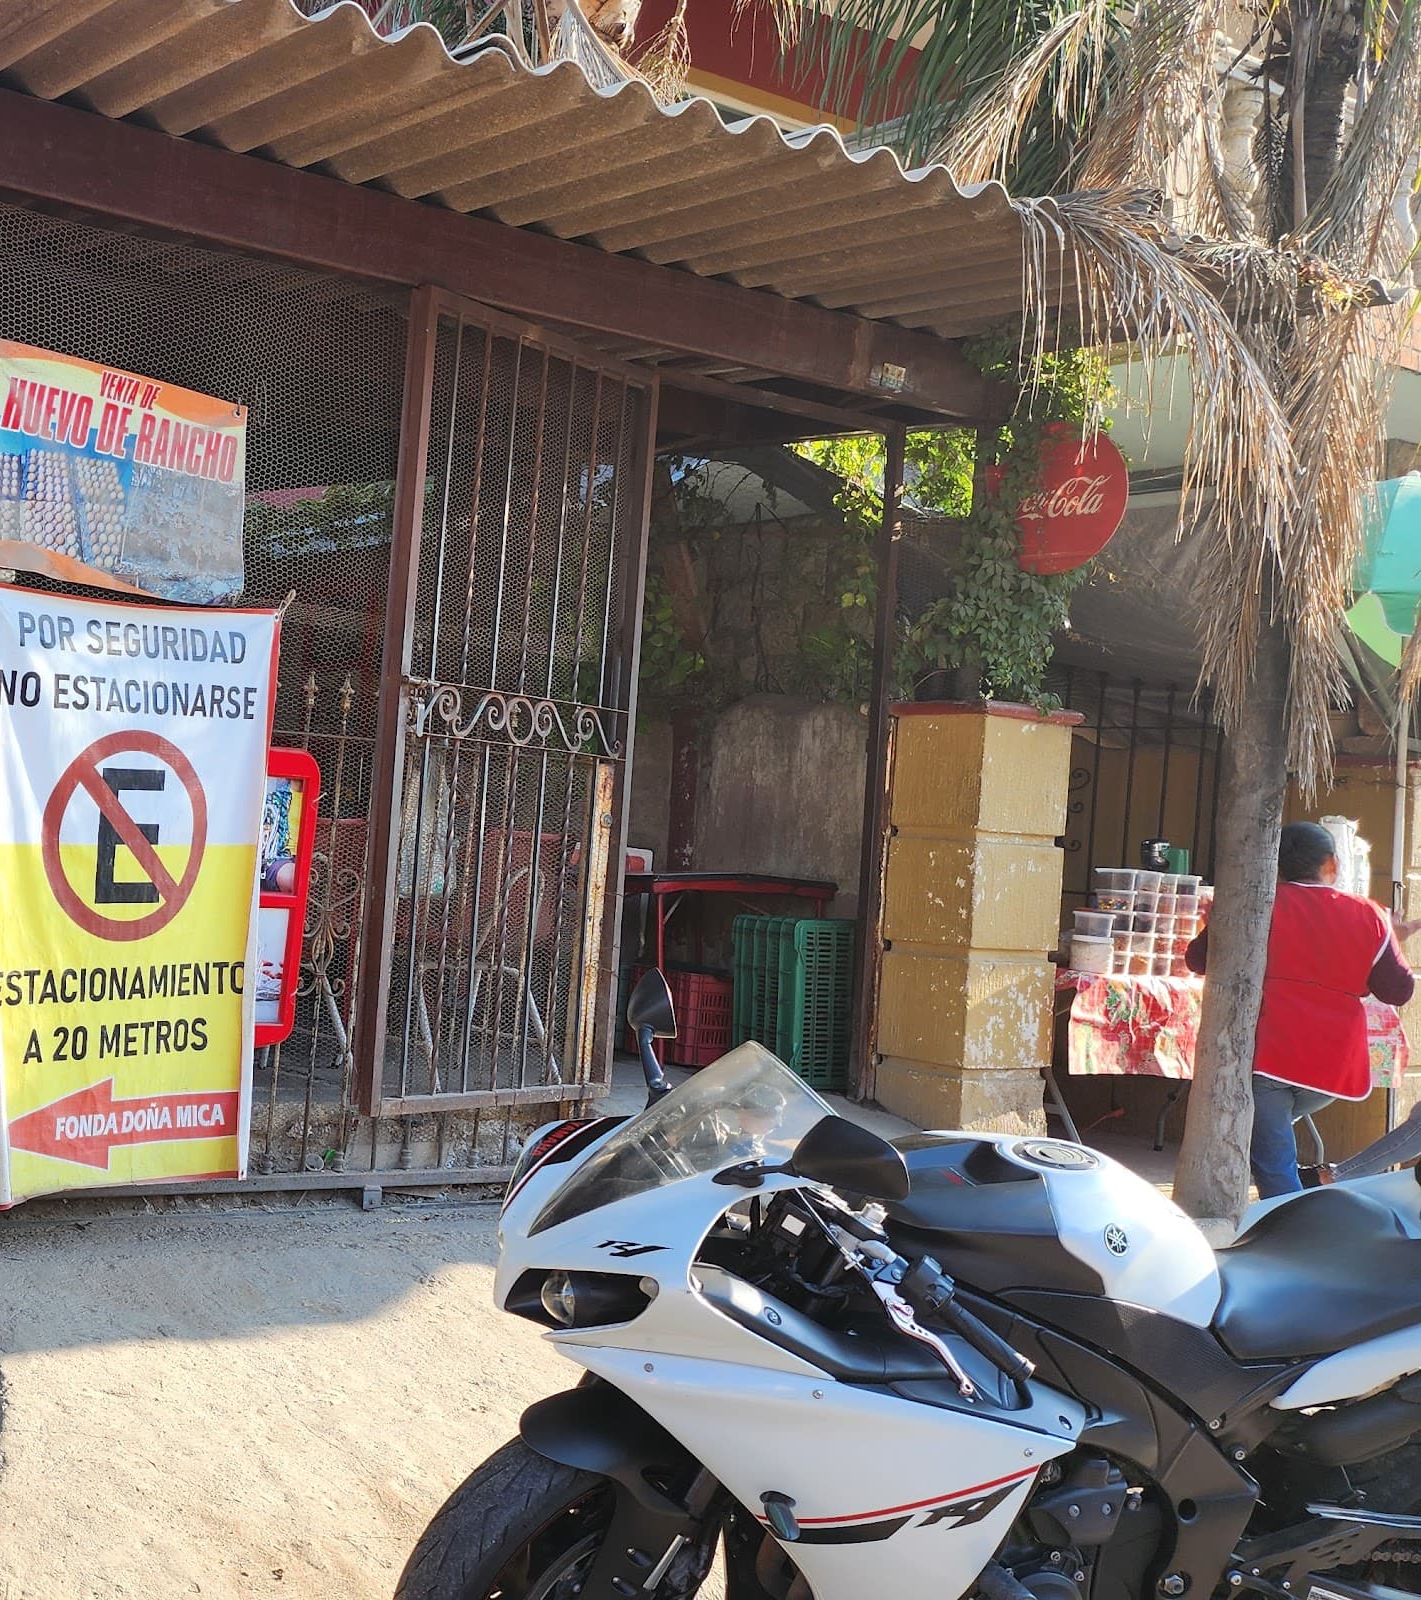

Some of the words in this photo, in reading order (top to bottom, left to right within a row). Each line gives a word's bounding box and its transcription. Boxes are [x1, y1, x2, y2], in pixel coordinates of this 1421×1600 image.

[100, 371, 143, 404] VENTA
[139, 384, 162, 410] DE
[0, 376, 95, 448] HUEVO
[95, 402, 133, 459] DE
[133, 414, 239, 484] RANCHO
[18, 611, 76, 652] POR
[87, 619, 247, 665] SEGURIDAD
[53, 673, 258, 720] ESTACIONARSE
[22, 1028, 43, 1065] A
[52, 1025, 88, 1063] 20
[99, 1017, 209, 1059] METROS
[55, 1112, 118, 1141] FONDA
[121, 1102, 172, 1133] DOÑA
[176, 1103, 225, 1128] MICA
